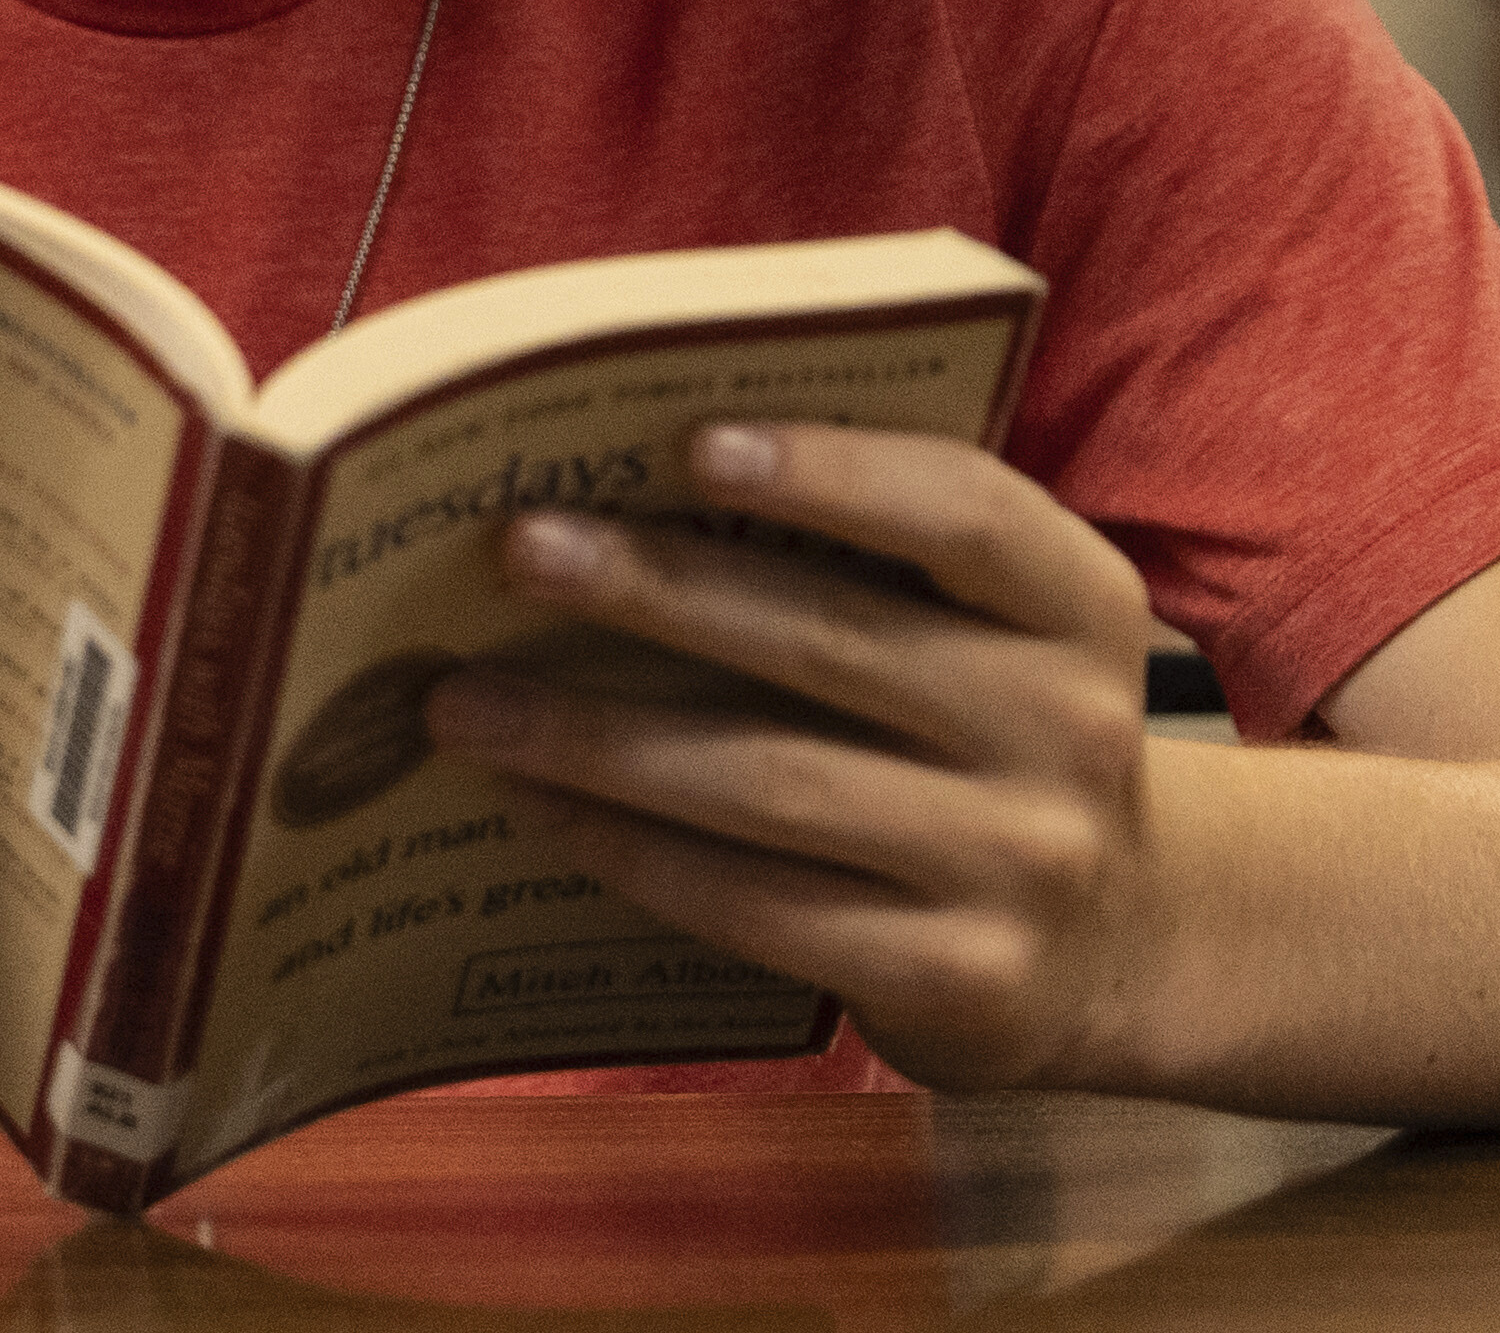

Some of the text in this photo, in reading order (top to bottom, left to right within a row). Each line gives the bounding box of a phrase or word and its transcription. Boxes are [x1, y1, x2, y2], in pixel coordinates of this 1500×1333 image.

[317, 835, 393, 894] old
[269, 918, 357, 985] and
[367, 885, 468, 941] life's
[476, 961, 615, 1001] Mitch
